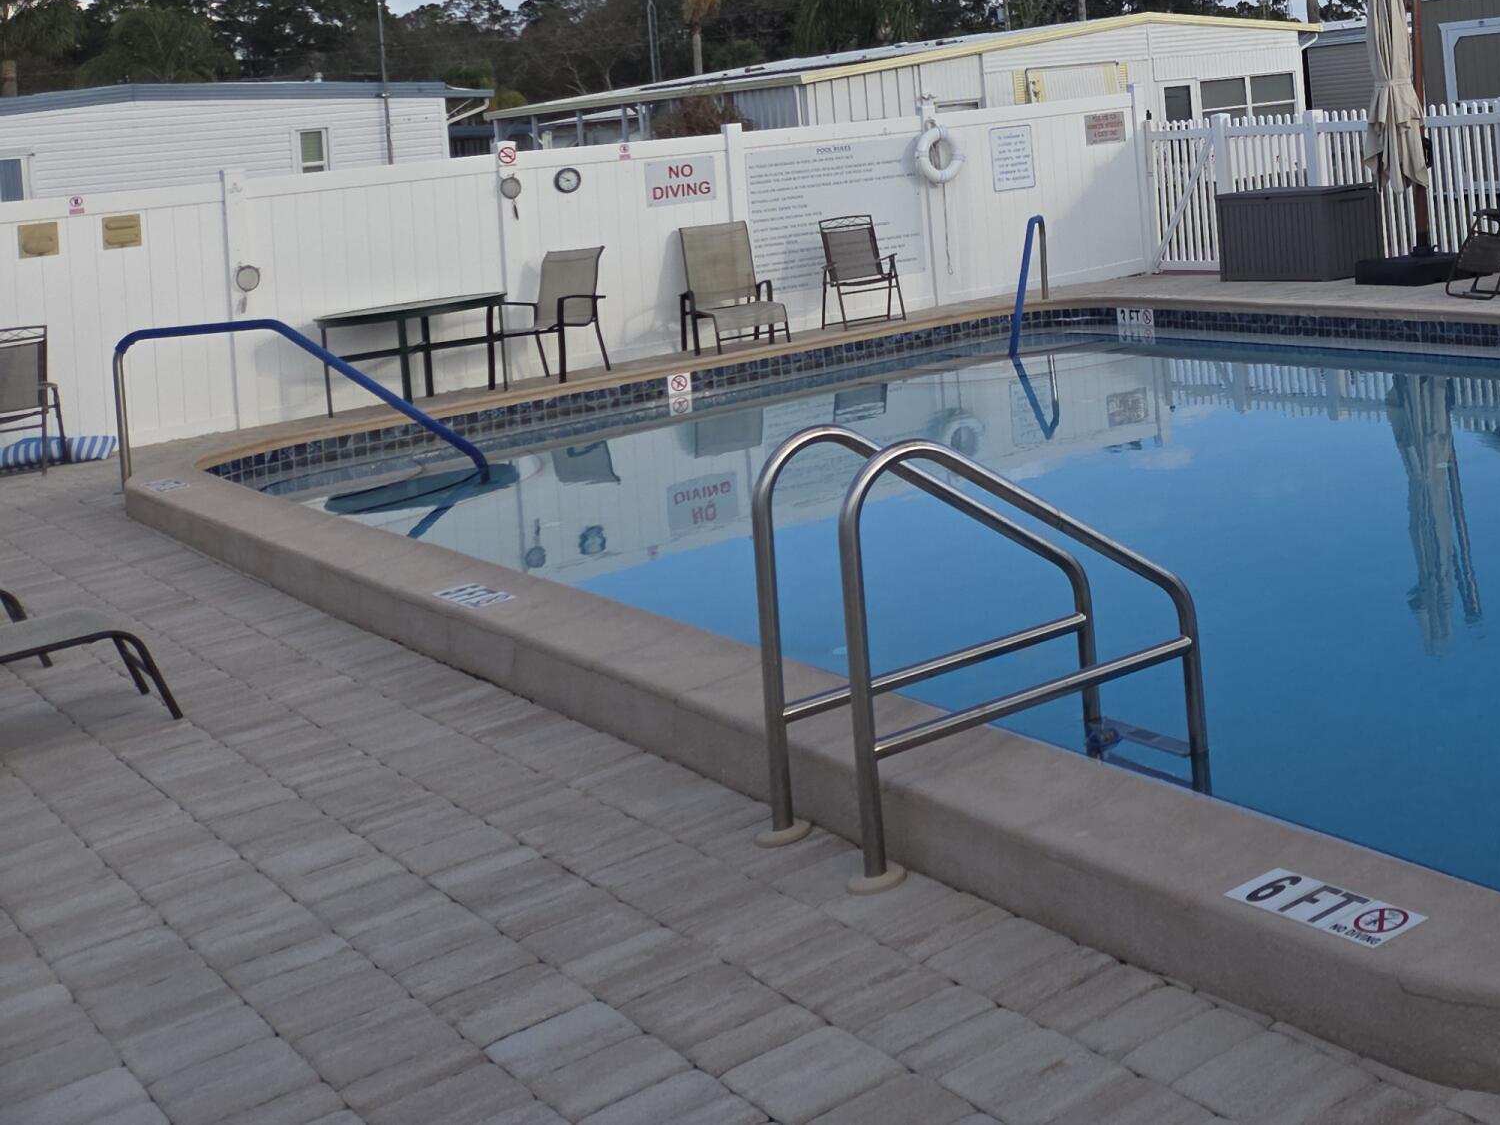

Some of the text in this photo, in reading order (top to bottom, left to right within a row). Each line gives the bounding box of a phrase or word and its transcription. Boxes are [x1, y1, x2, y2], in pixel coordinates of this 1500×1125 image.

[668, 163, 693, 179] NO
[652, 181, 711, 200] DIVING
[1129, 308, 1140, 323] FT
[1246, 875, 1370, 924] 6 FT
[1329, 923, 1382, 945] NO DIVING
